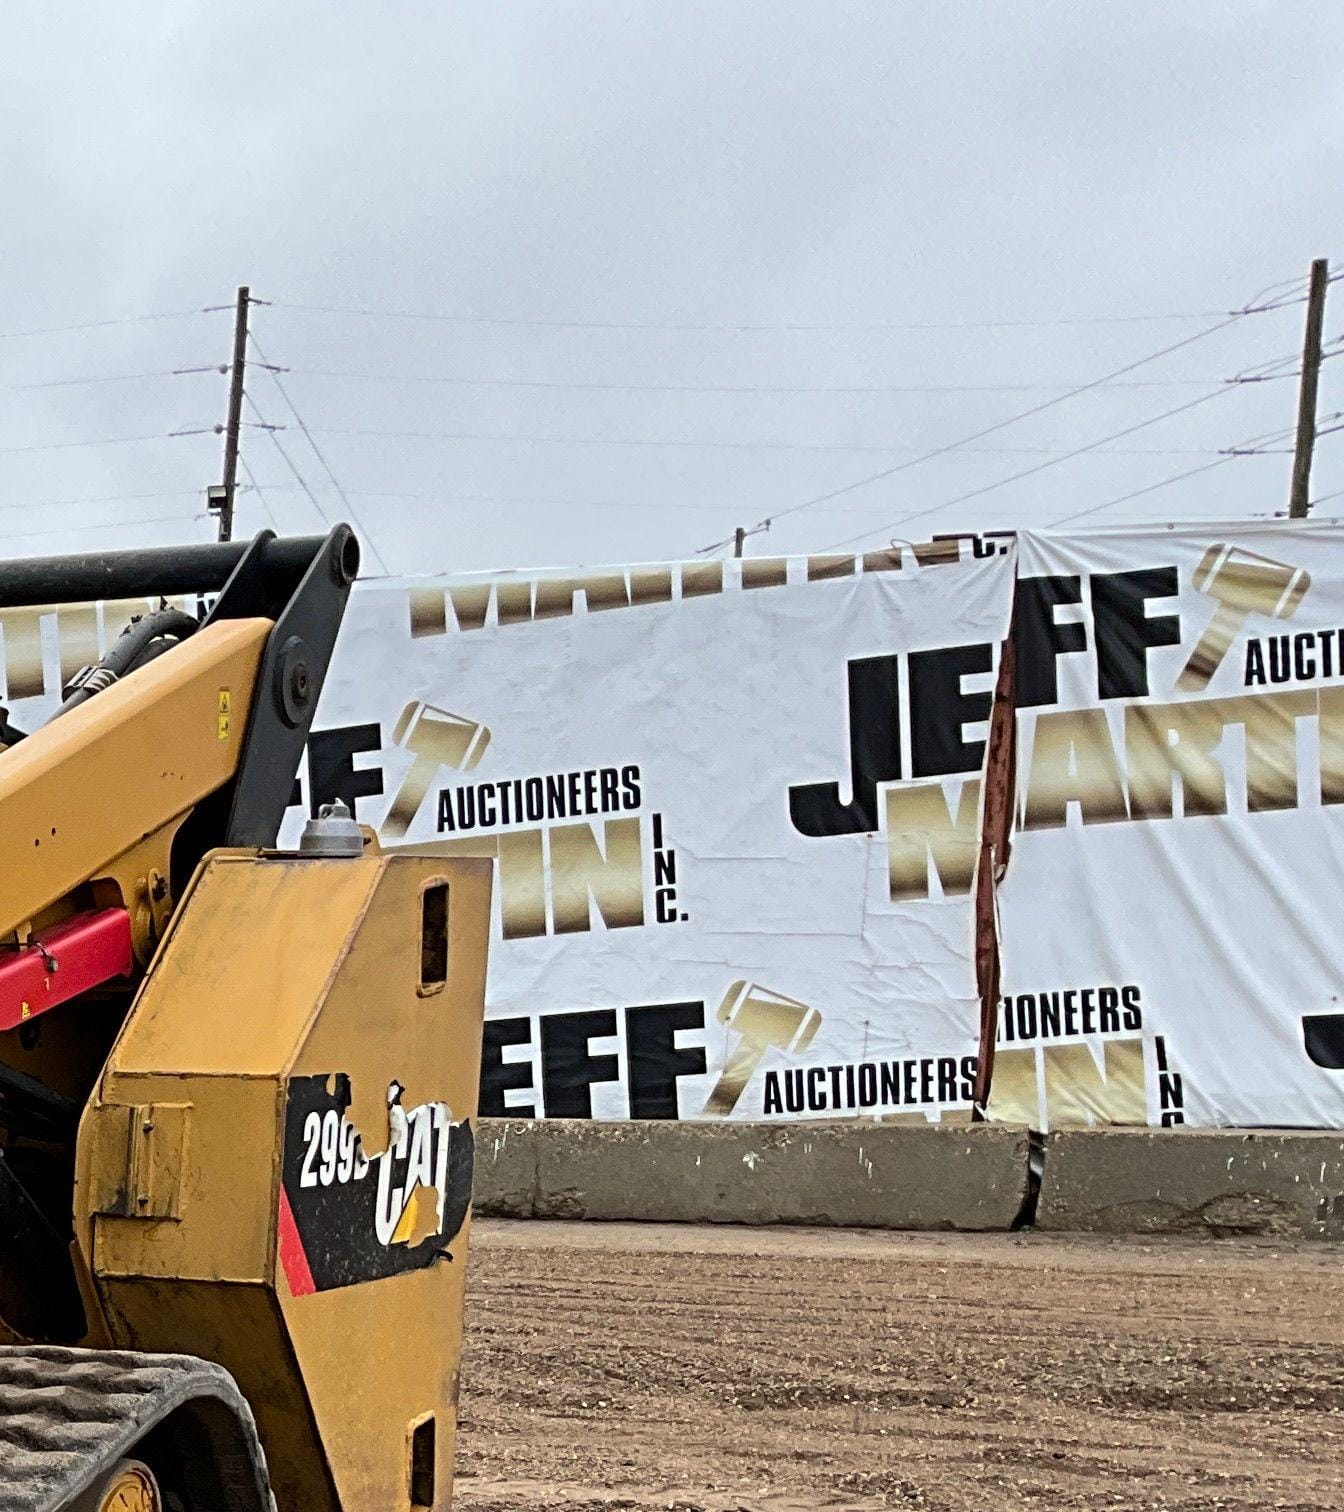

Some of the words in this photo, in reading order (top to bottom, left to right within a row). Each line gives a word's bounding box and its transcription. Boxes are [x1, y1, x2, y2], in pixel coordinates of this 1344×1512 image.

[437, 765, 642, 833] AUCTIONEERS
[997, 985, 1143, 1043] IONEERS
[763, 1056, 978, 1114] AUCTIONEERS
[375, 1100, 453, 1246] CAT
